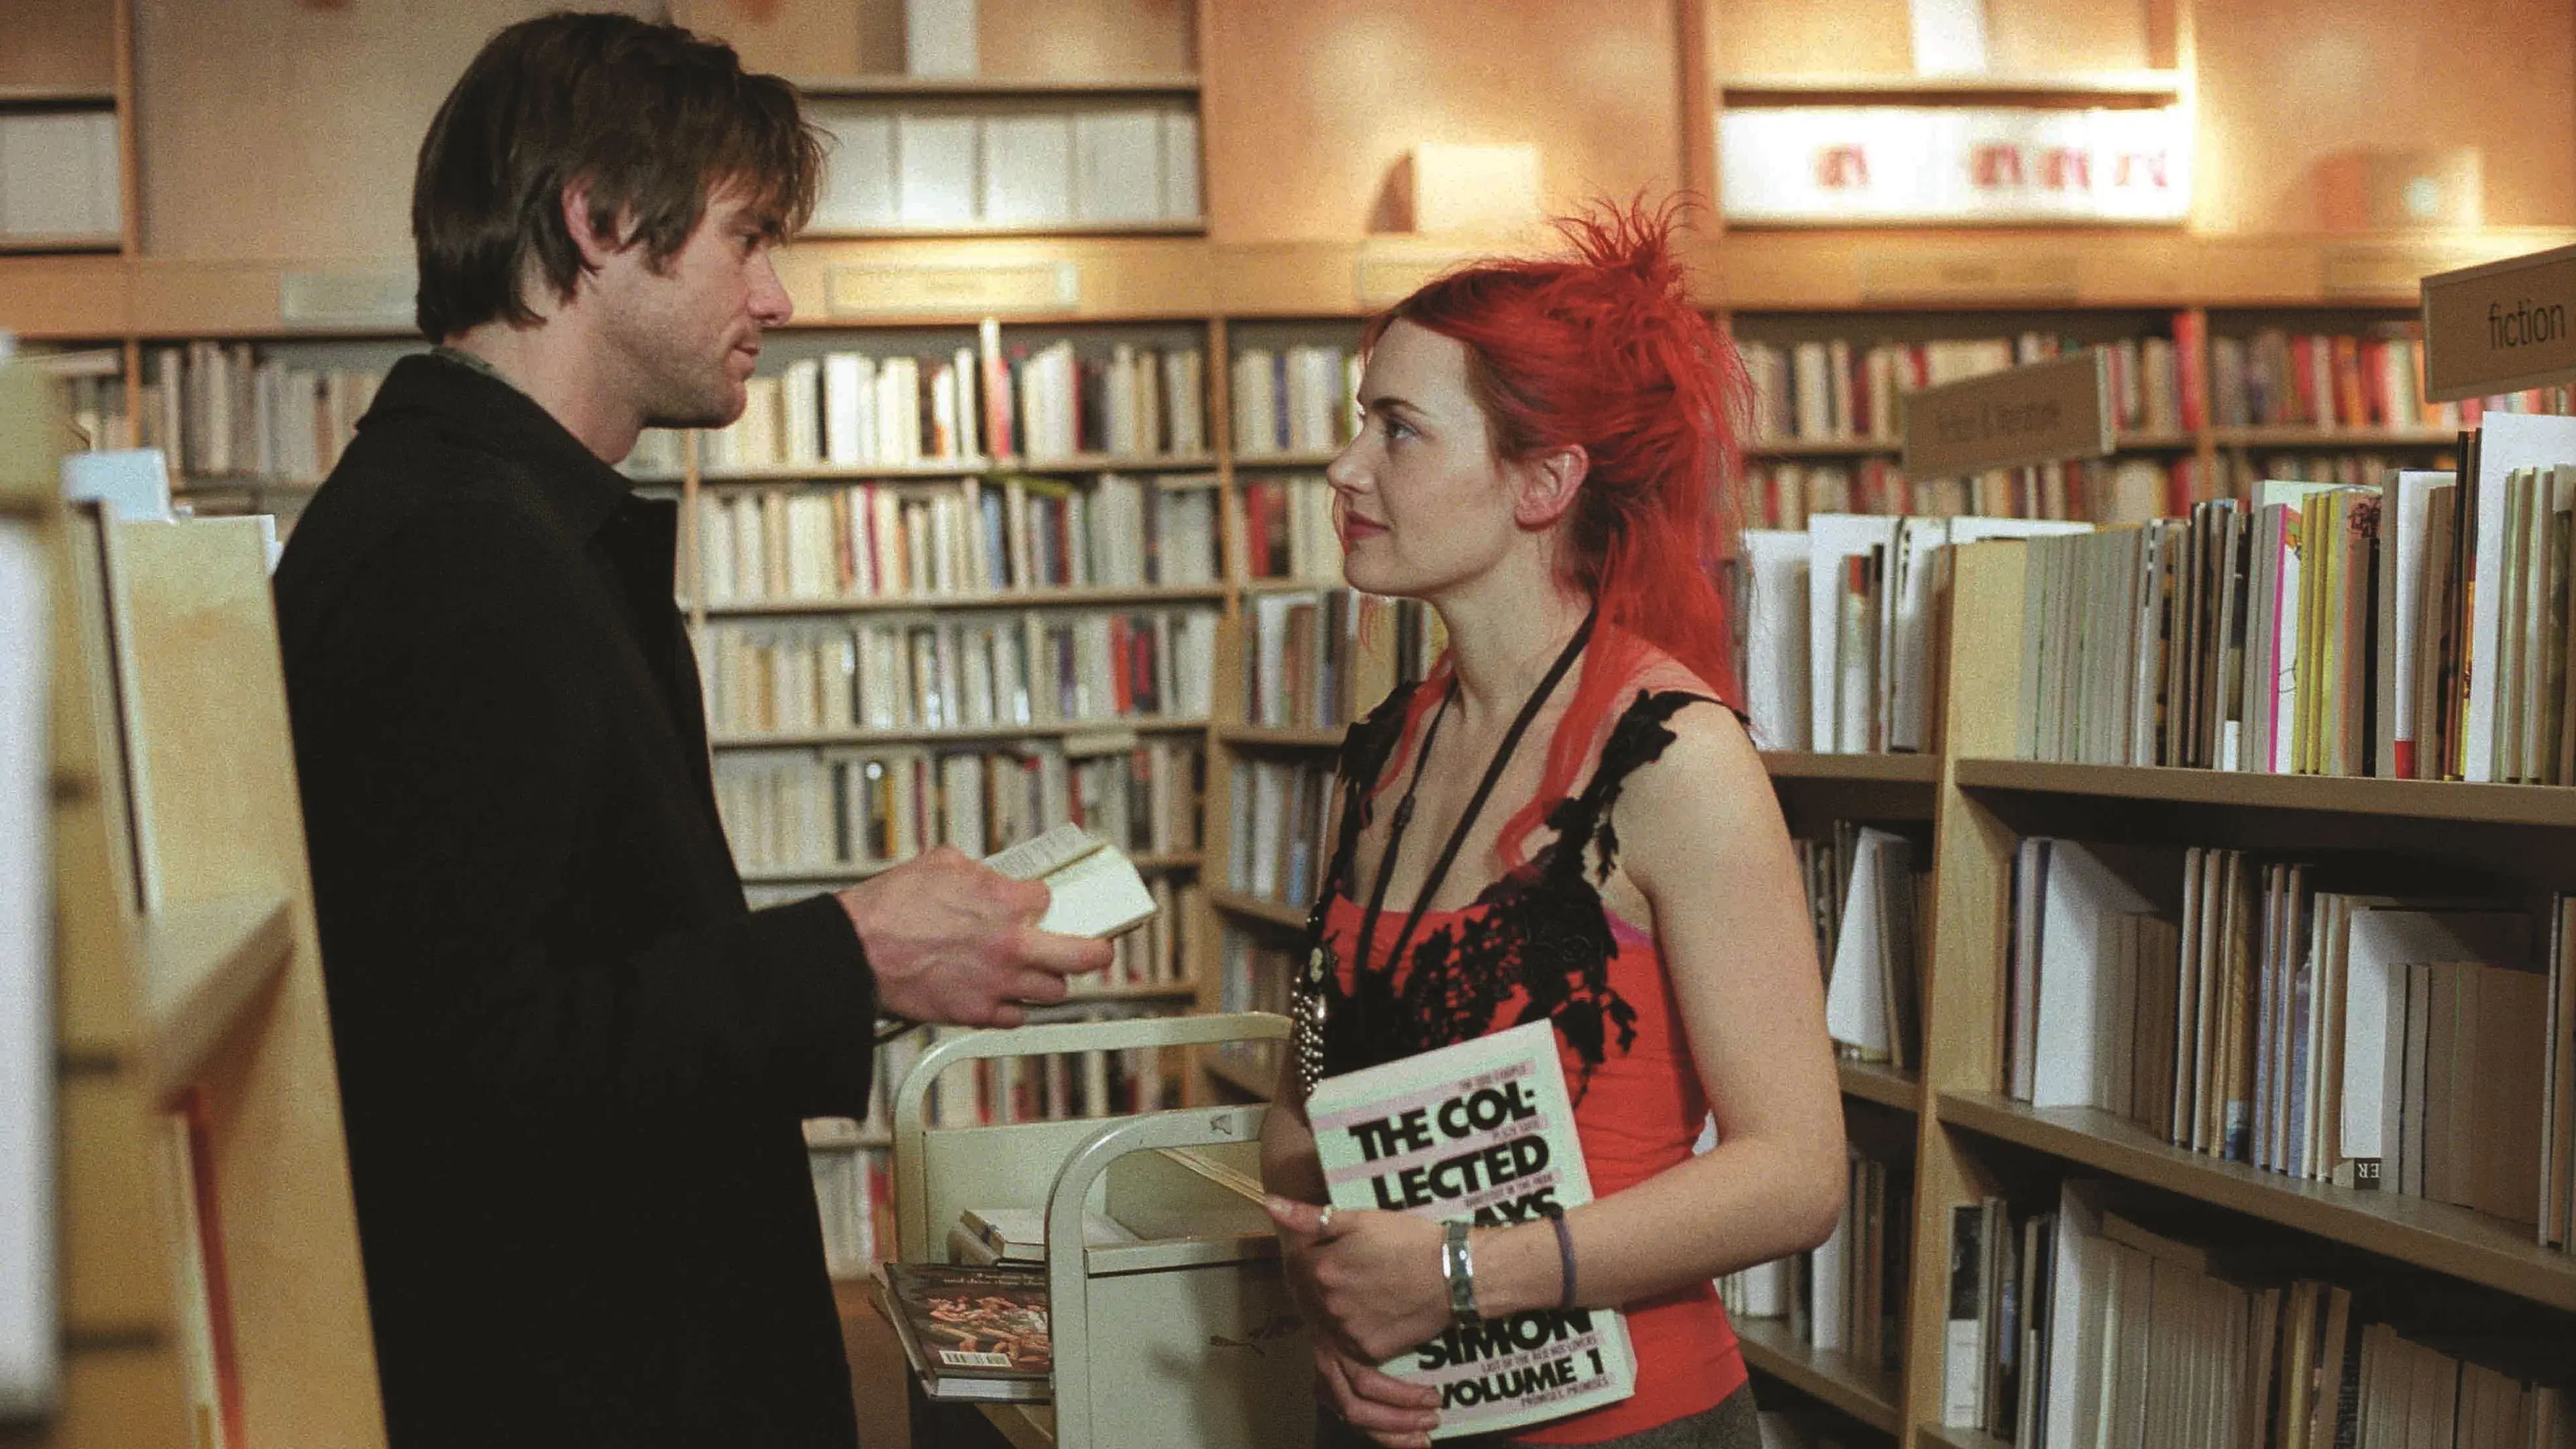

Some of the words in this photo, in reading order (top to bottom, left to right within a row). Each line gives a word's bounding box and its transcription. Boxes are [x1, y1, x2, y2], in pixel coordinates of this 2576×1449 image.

[2488, 299, 2565, 350] fiction
[1348, 1108, 1434, 1162] THE
[1372, 1135, 1549, 1210] LECTED
[1474, 1186, 1564, 1228] AYS
[1413, 1309, 1593, 1370] SIMON
[1587, 1348, 1604, 1375] 1
